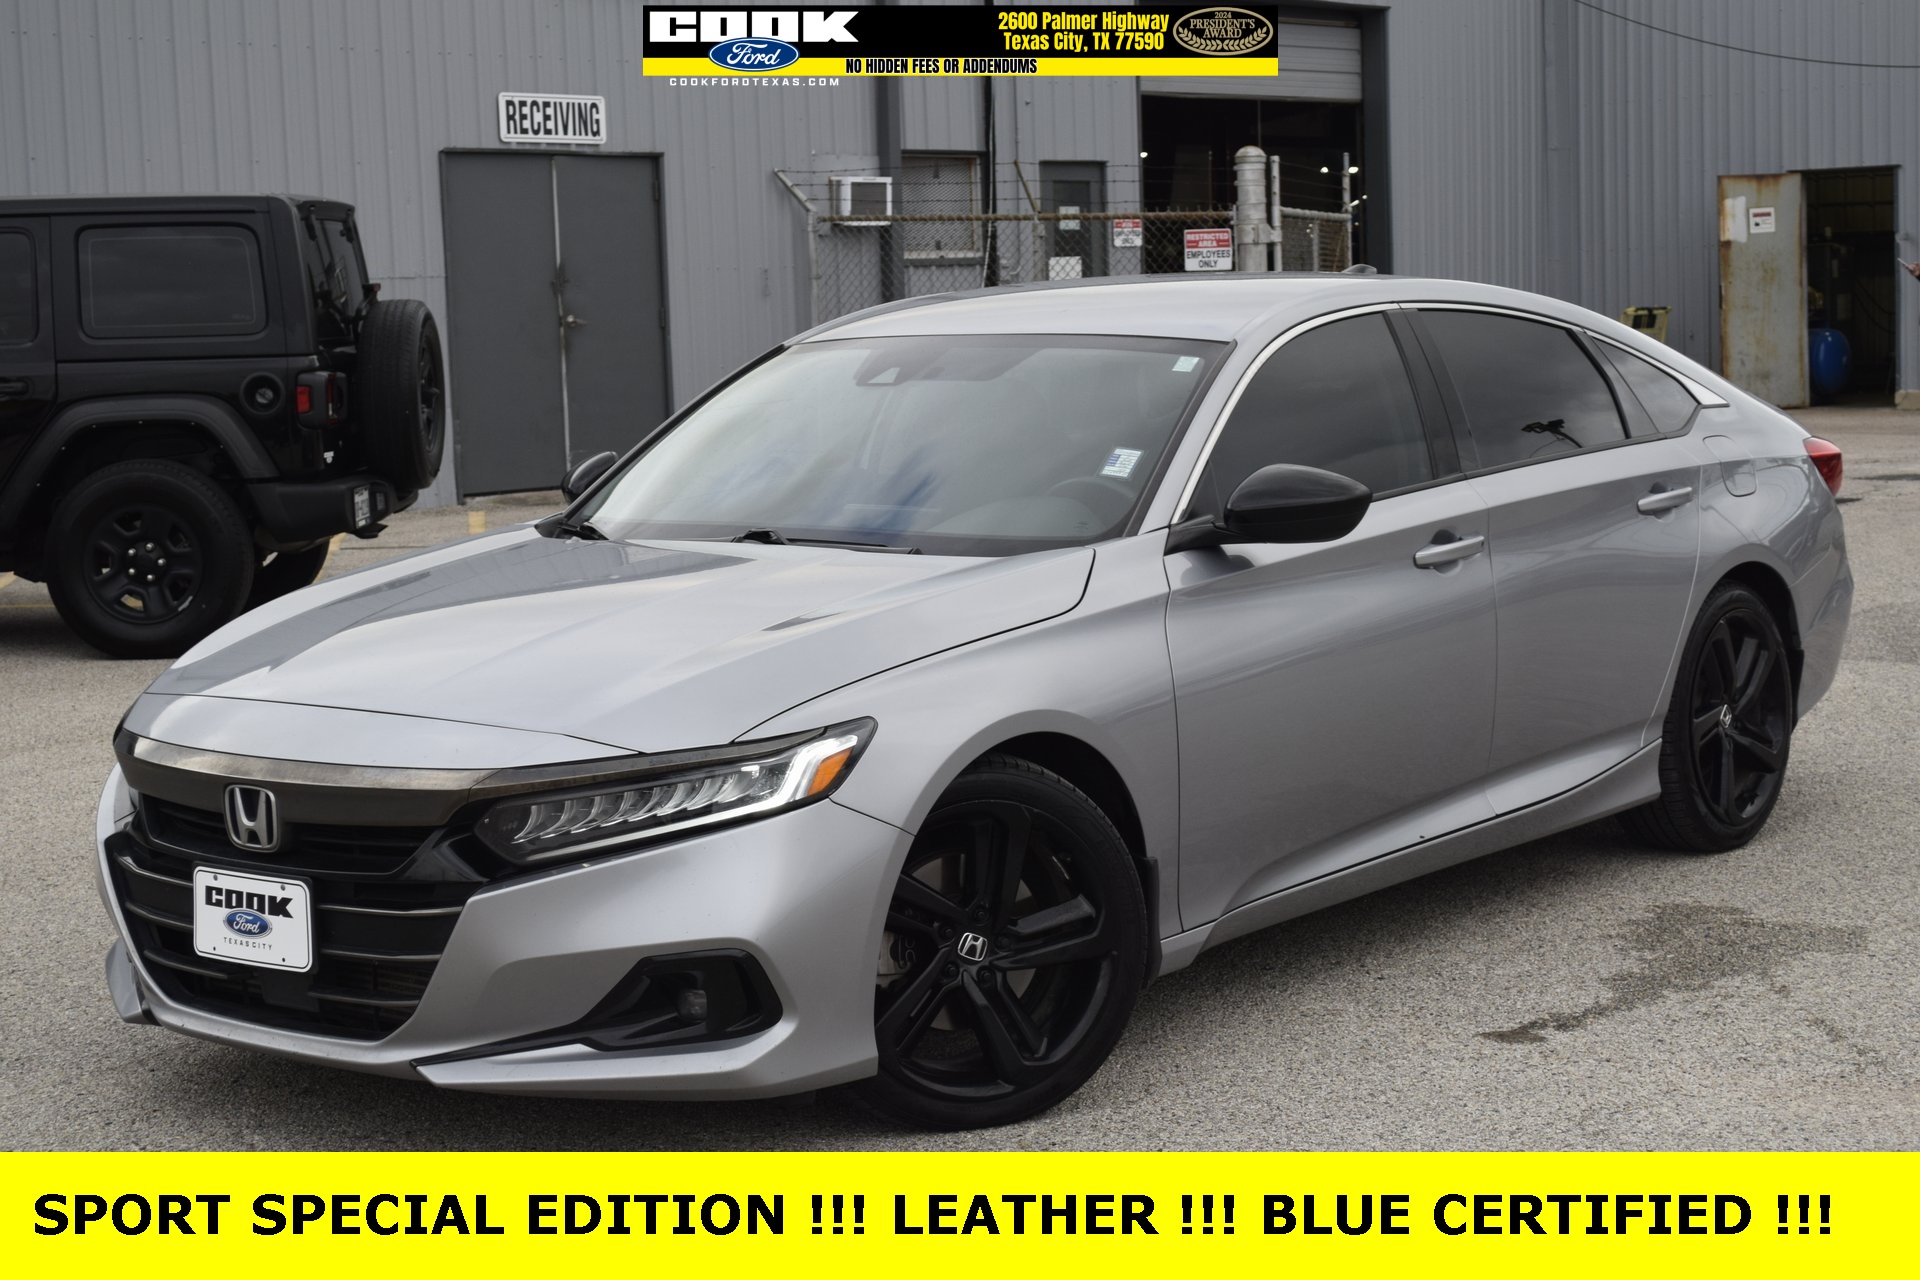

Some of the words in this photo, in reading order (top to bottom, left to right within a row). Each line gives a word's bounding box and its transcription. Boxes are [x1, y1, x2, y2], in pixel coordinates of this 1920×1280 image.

[505, 99, 600, 137] RECEIVING
[1185, 232, 1229, 240] RESTRICTED
[1186, 249, 1231, 259] EMPLOYEES
[1198, 259, 1218, 268] ONLY
[205, 885, 294, 919] COOK
[233, 913, 260, 934] Ford
